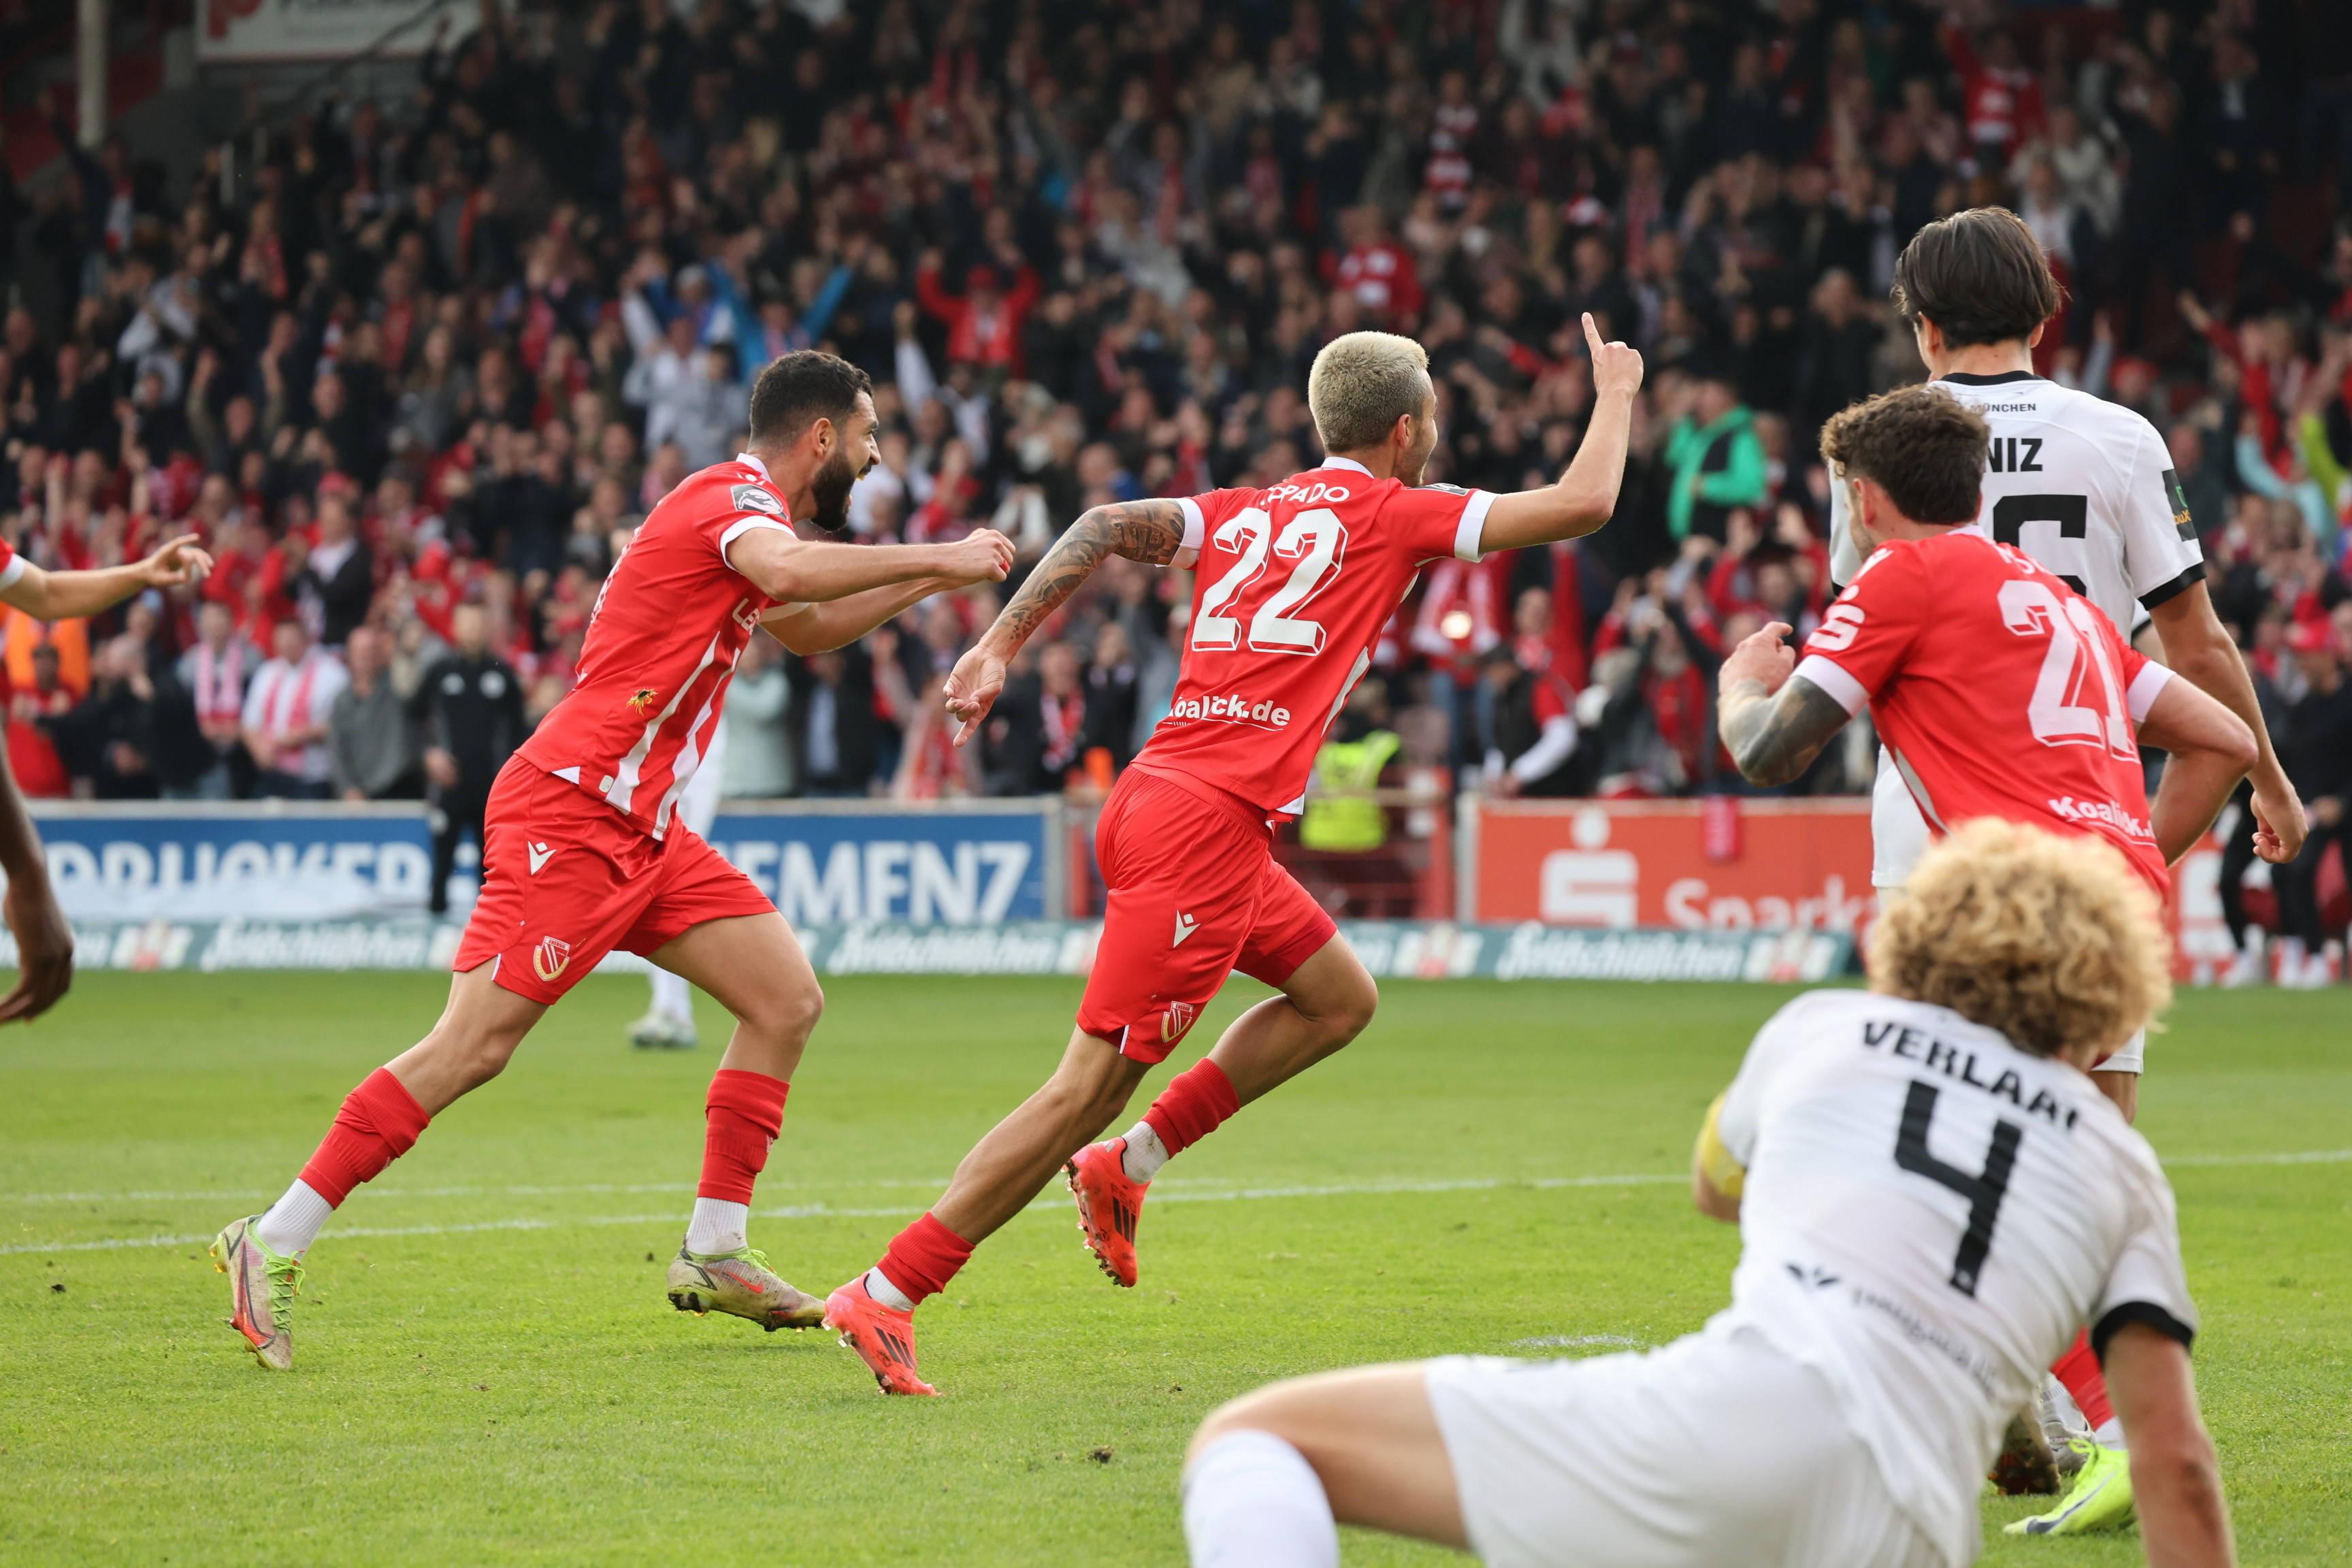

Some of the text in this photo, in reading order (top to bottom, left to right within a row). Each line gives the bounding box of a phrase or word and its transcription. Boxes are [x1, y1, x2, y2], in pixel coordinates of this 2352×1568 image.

[1260, 483, 1350, 506] OPADO
[1191, 508, 1349, 657] 22
[1168, 694, 1291, 726] oalck.de
[1893, 1079, 2023, 1298] 4
